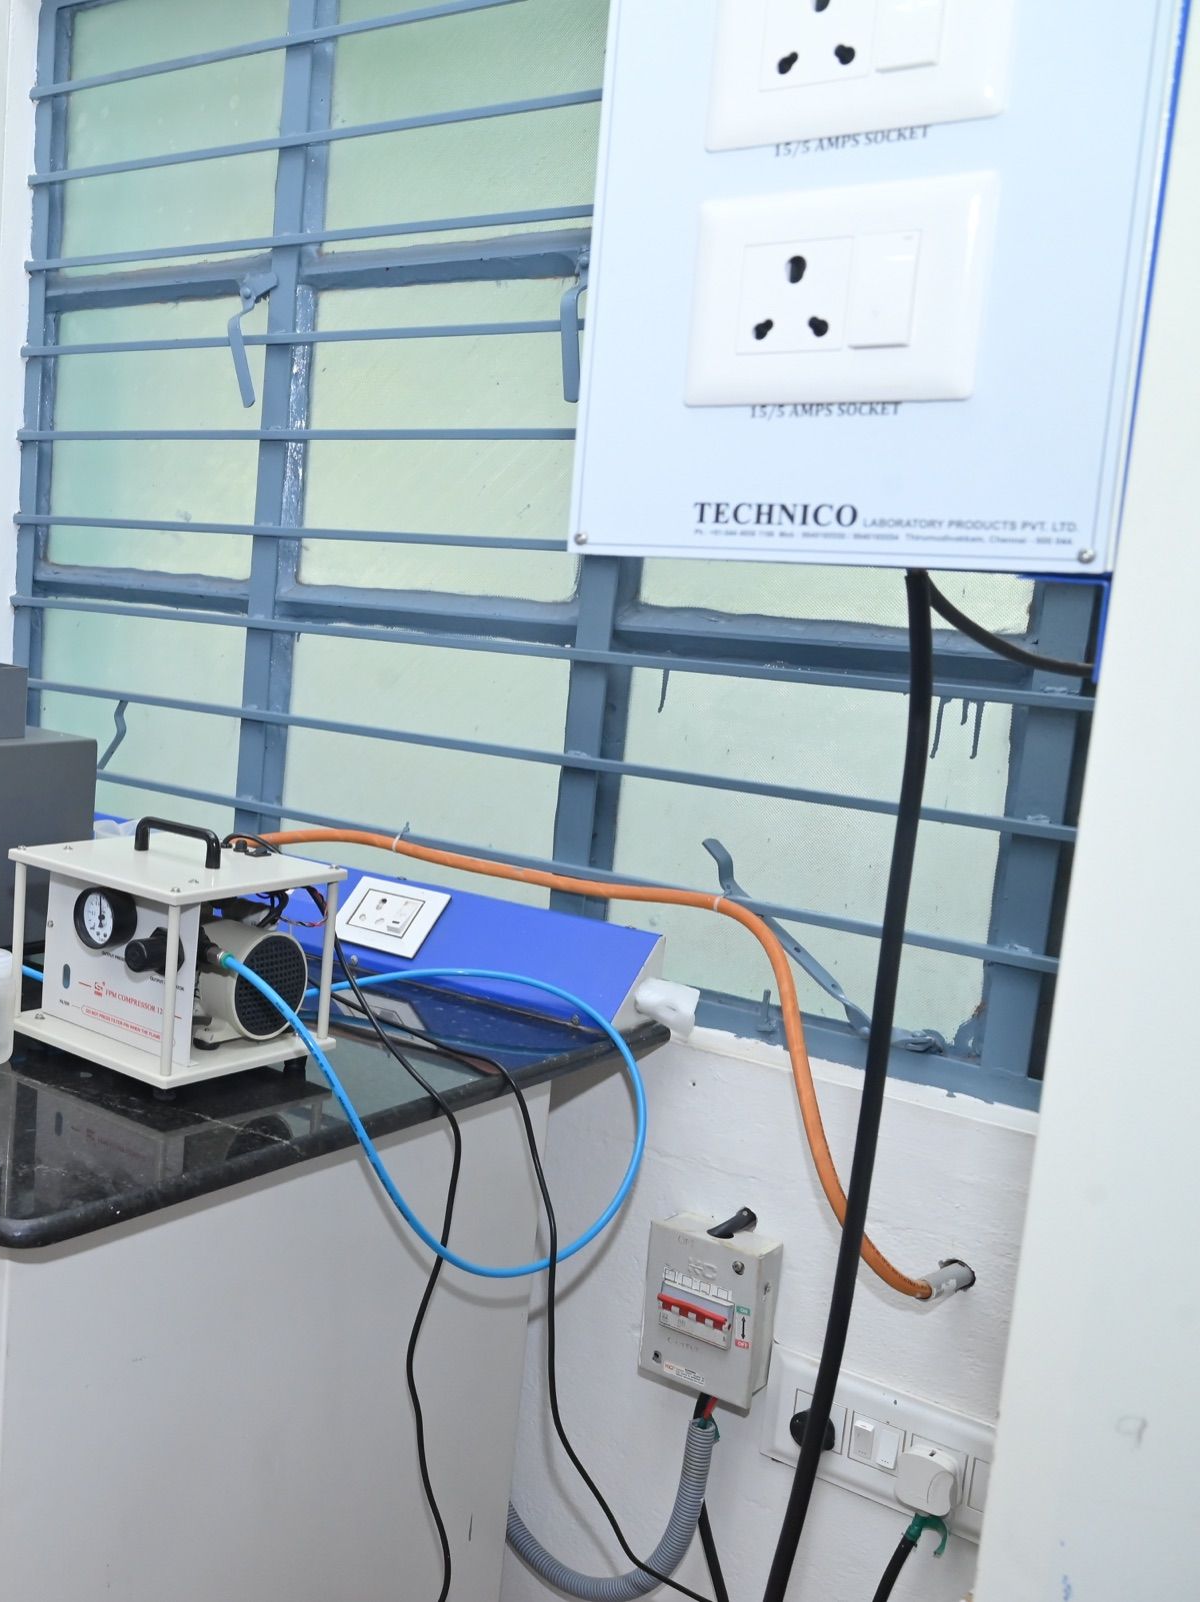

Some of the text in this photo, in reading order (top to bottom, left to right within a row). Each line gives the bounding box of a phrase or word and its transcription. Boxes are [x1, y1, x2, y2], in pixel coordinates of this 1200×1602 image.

[774, 124, 932, 158] 15/5 AMPS SOCKET
[750, 400, 903, 421] 15/5 AMPS SOCKET
[693, 502, 858, 527] TECHNICO
[862, 516, 943, 530] LABORATORY
[948, 518, 1017, 532] PRODUCTS
[117, 993, 156, 1013] COMPRESSOR
